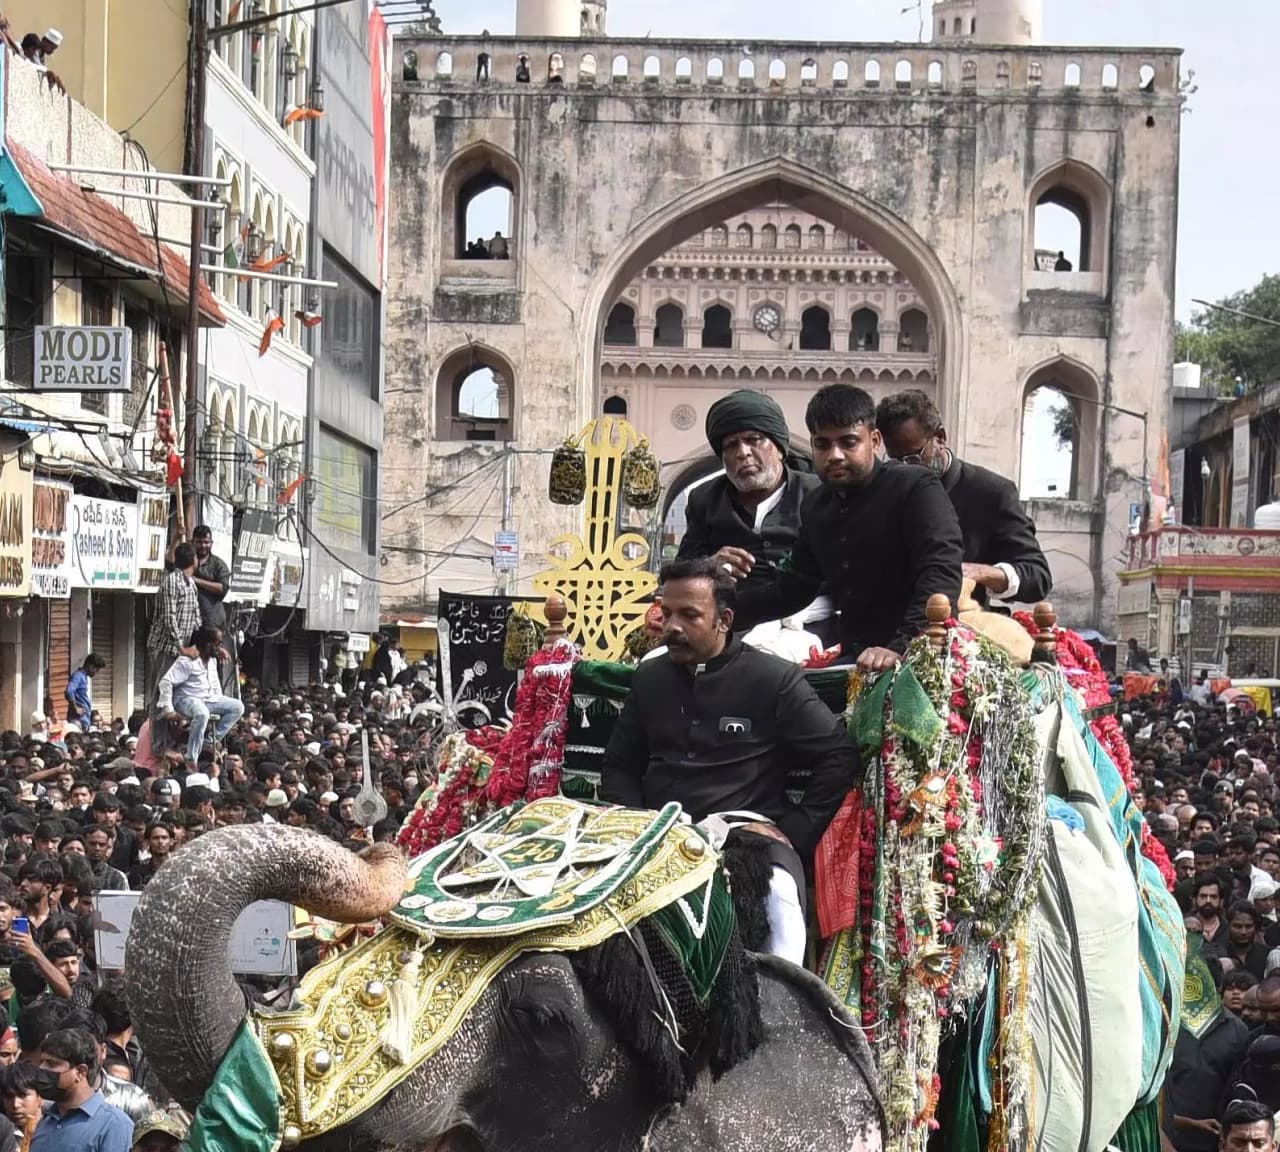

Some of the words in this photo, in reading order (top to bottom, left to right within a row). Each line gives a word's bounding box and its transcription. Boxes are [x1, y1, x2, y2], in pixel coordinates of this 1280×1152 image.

[40, 330, 122, 362] MODI
[40, 365, 122, 385] PEARLS
[109, 530, 114, 558] &
[117, 529, 134, 558] Sons
